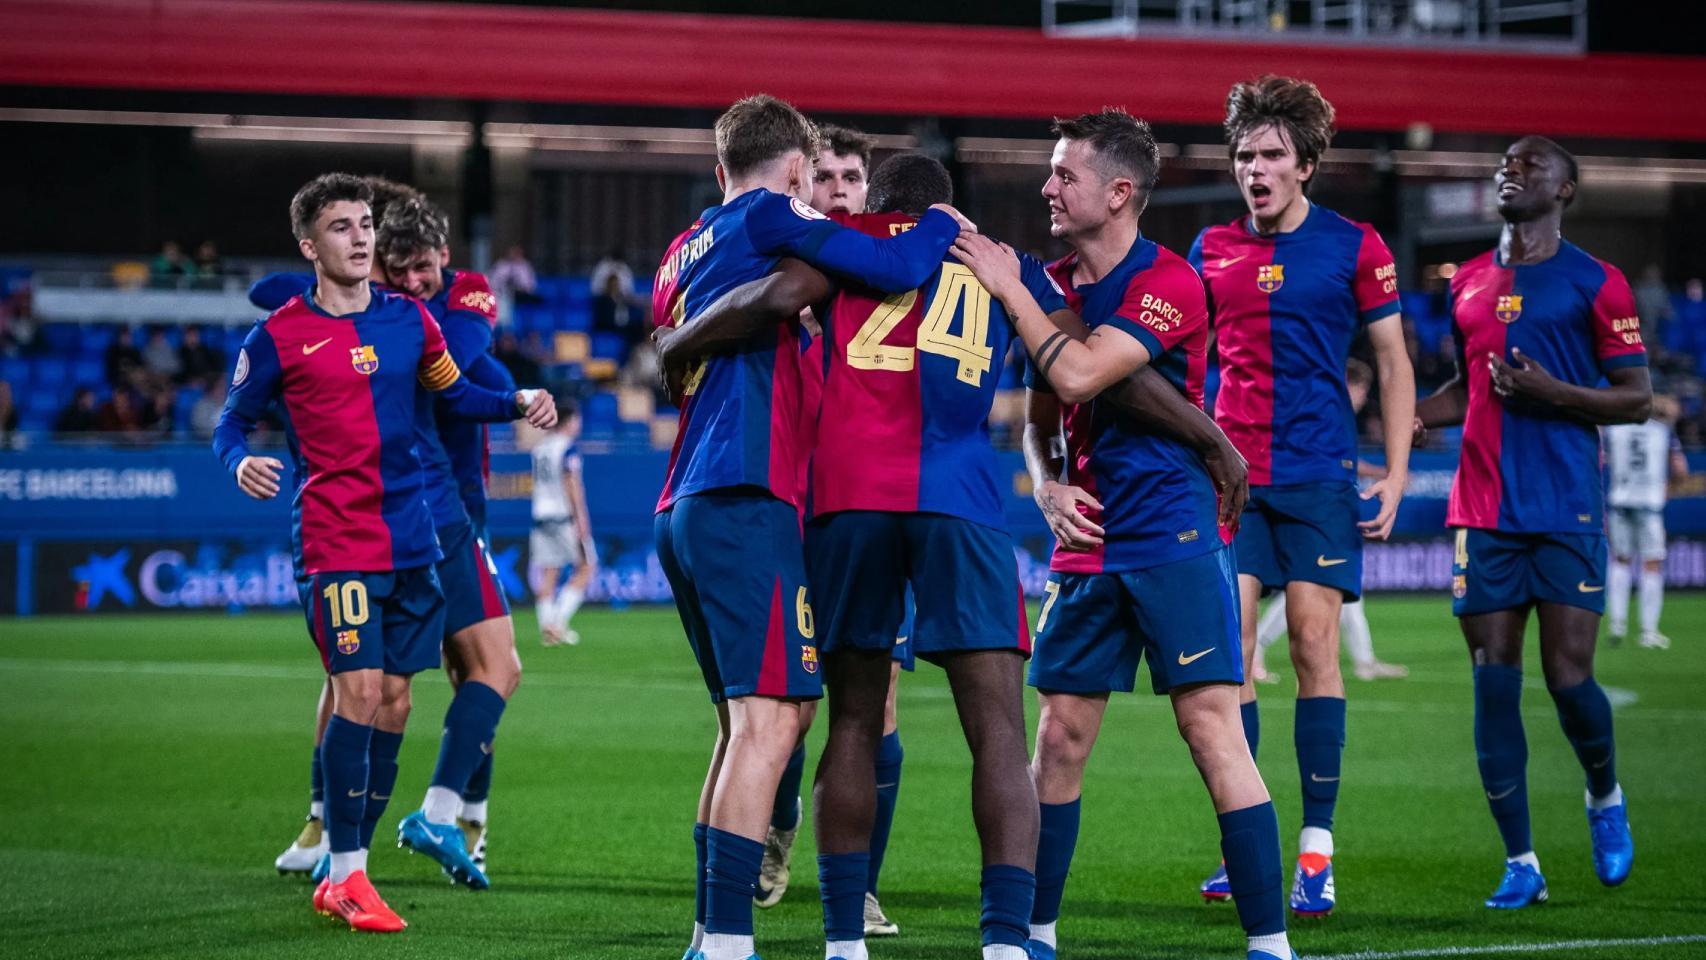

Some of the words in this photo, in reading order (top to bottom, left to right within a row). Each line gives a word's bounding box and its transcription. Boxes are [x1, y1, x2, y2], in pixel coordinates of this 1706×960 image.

[680, 225, 714, 271] PRIM
[889, 222, 917, 237] CE
[846, 261, 994, 388] 24
[1139, 310, 1170, 332] One
[1629, 438, 1647, 471] 5
[25, 469, 176, 499] BARCELONA
[139, 549, 303, 608] CaixaB
[323, 580, 369, 628] 10
[796, 585, 815, 639] 6
[1036, 579, 1061, 633] 7
